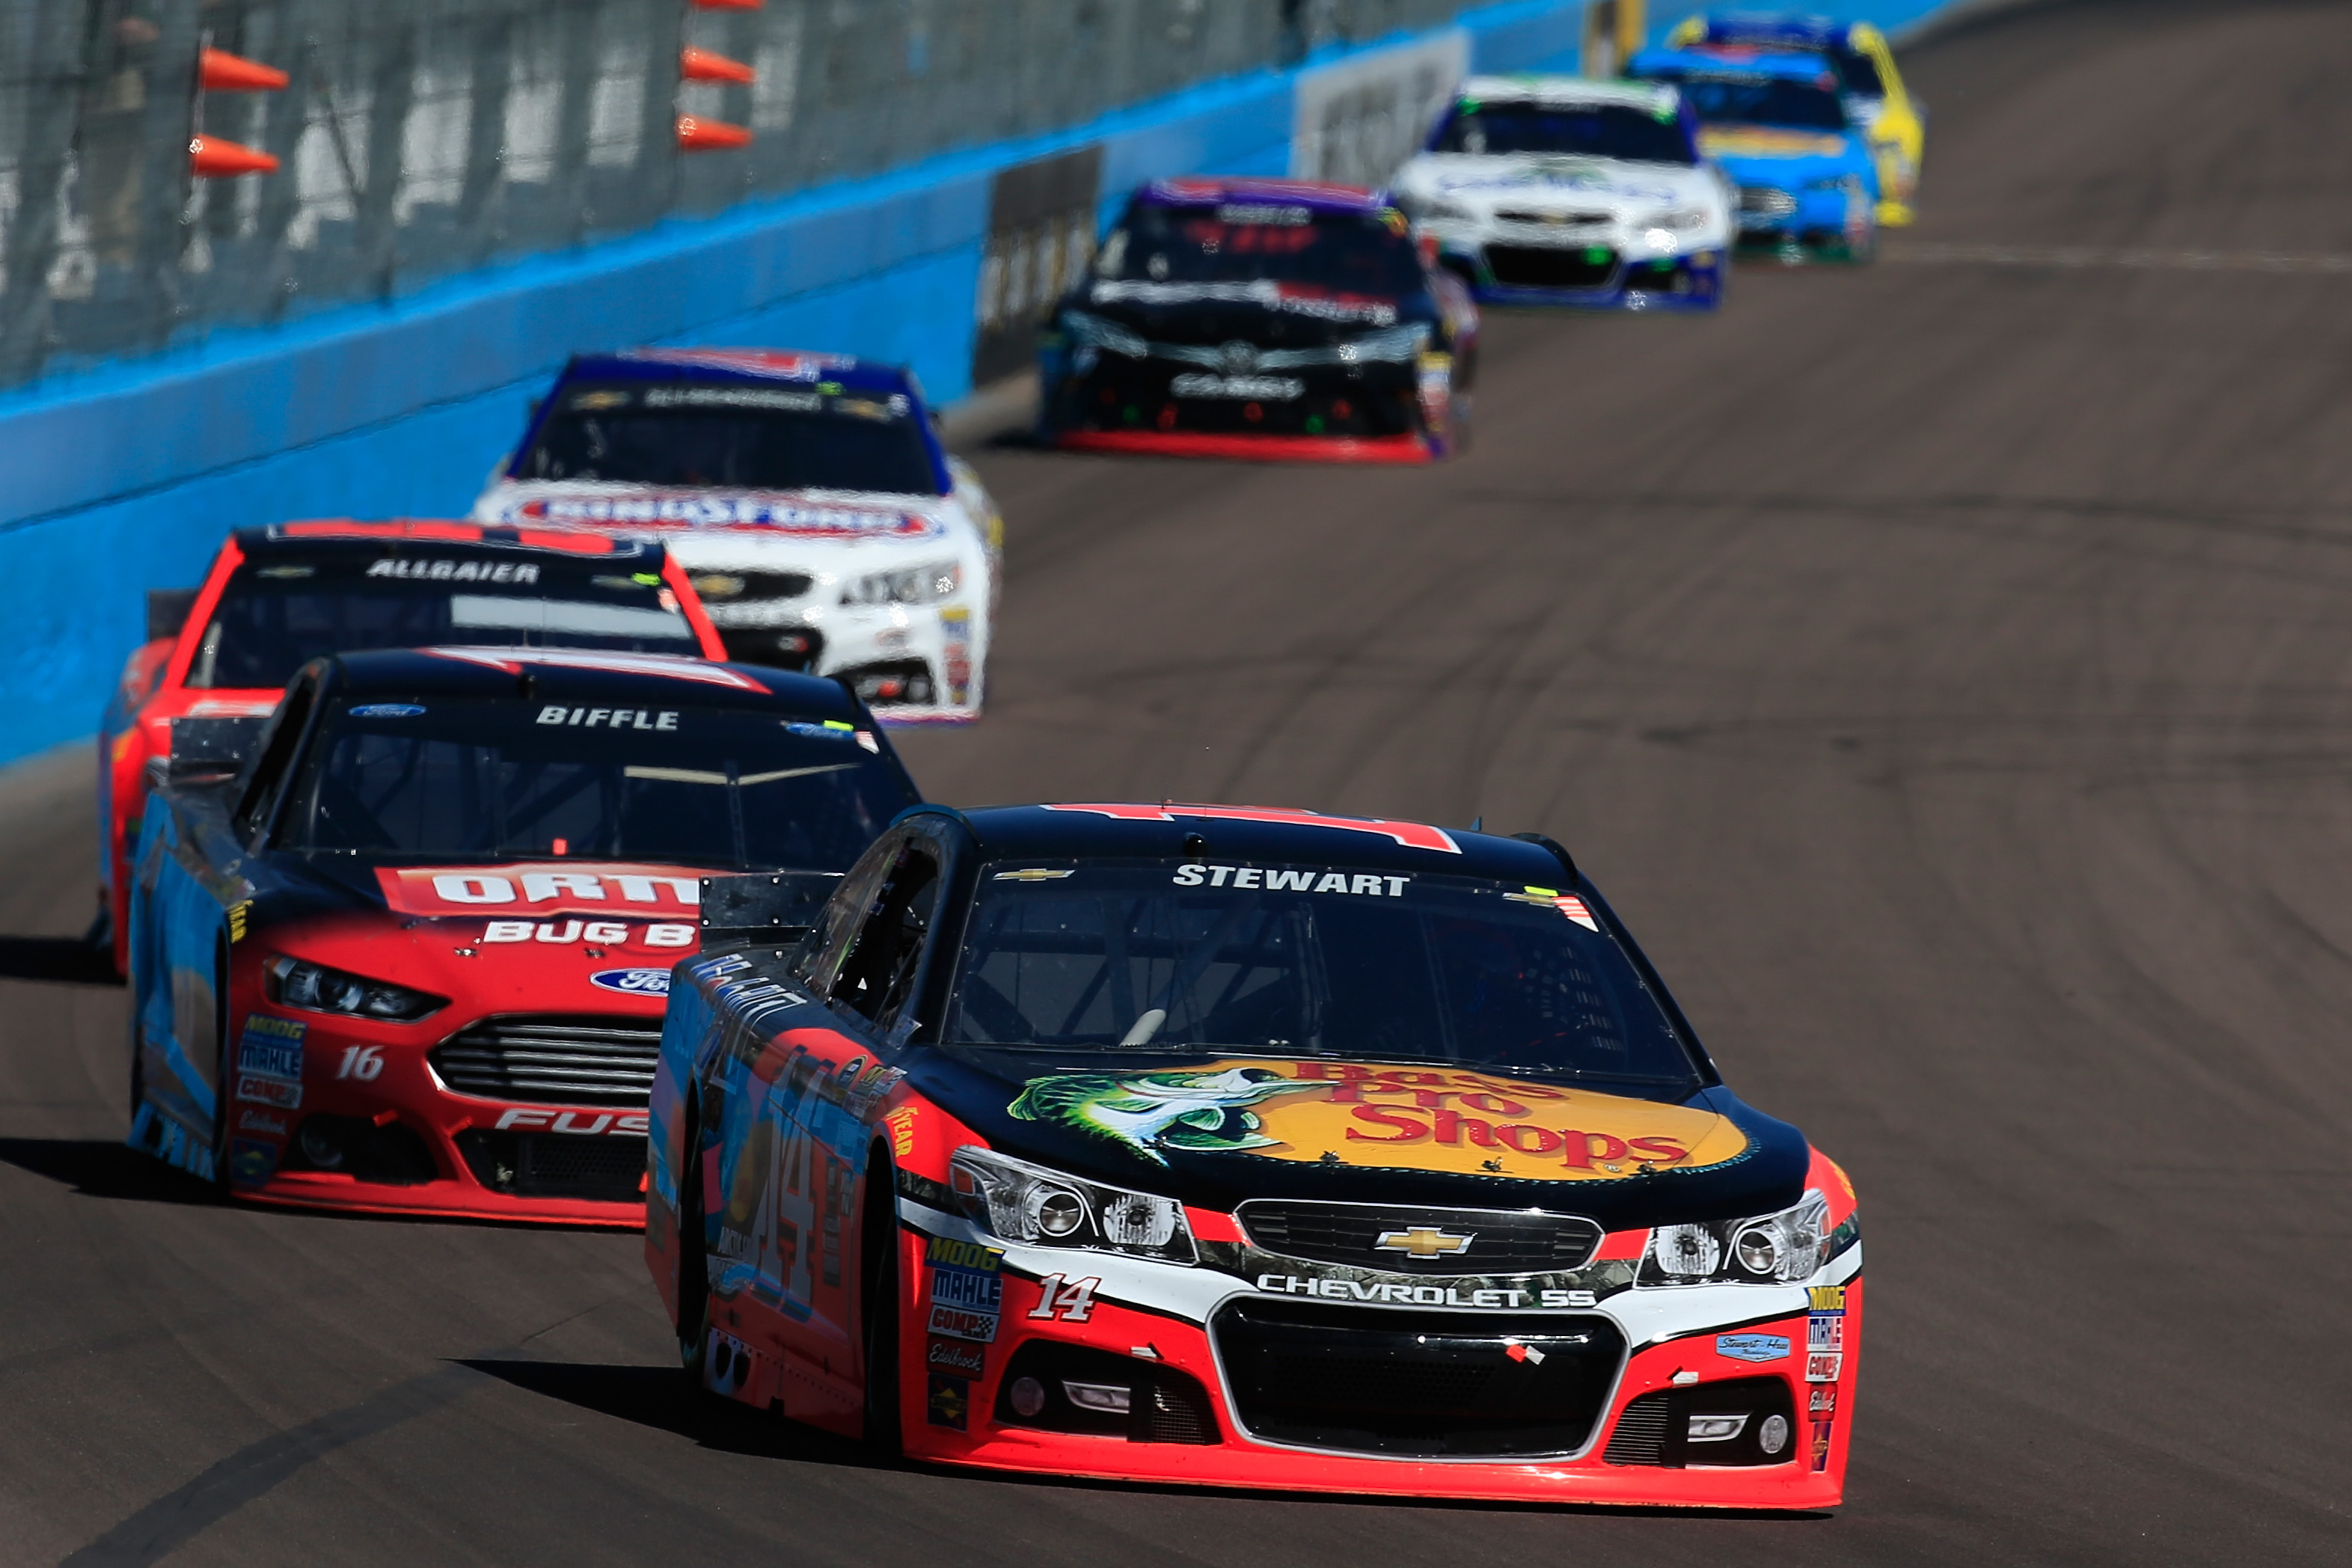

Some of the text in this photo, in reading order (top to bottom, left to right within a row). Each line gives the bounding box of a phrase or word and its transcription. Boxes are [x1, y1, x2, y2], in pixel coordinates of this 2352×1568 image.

[366, 559, 541, 585] ALLGAIER
[536, 705, 679, 731] BIFFLE
[1172, 864, 1410, 897] STEWART
[483, 919, 696, 947] BUG B
[247, 1014, 307, 1039] MOOG
[240, 1045, 301, 1075] MAHLE
[337, 1044, 386, 1082] 16
[1294, 1062, 1565, 1100] Bass
[1323, 1080, 1528, 1115] Pro
[1347, 1103, 1689, 1170] Shops
[927, 1237, 1003, 1271] MOOG
[933, 1272, 1002, 1306] MAHLE
[1026, 1273, 1103, 1323] 14
[1257, 1274, 1598, 1308] CHEVROLET SS
[1810, 1287, 1846, 1311] MOOG
[932, 1308, 979, 1332] COMP
[928, 1344, 981, 1371] Edelbrock
